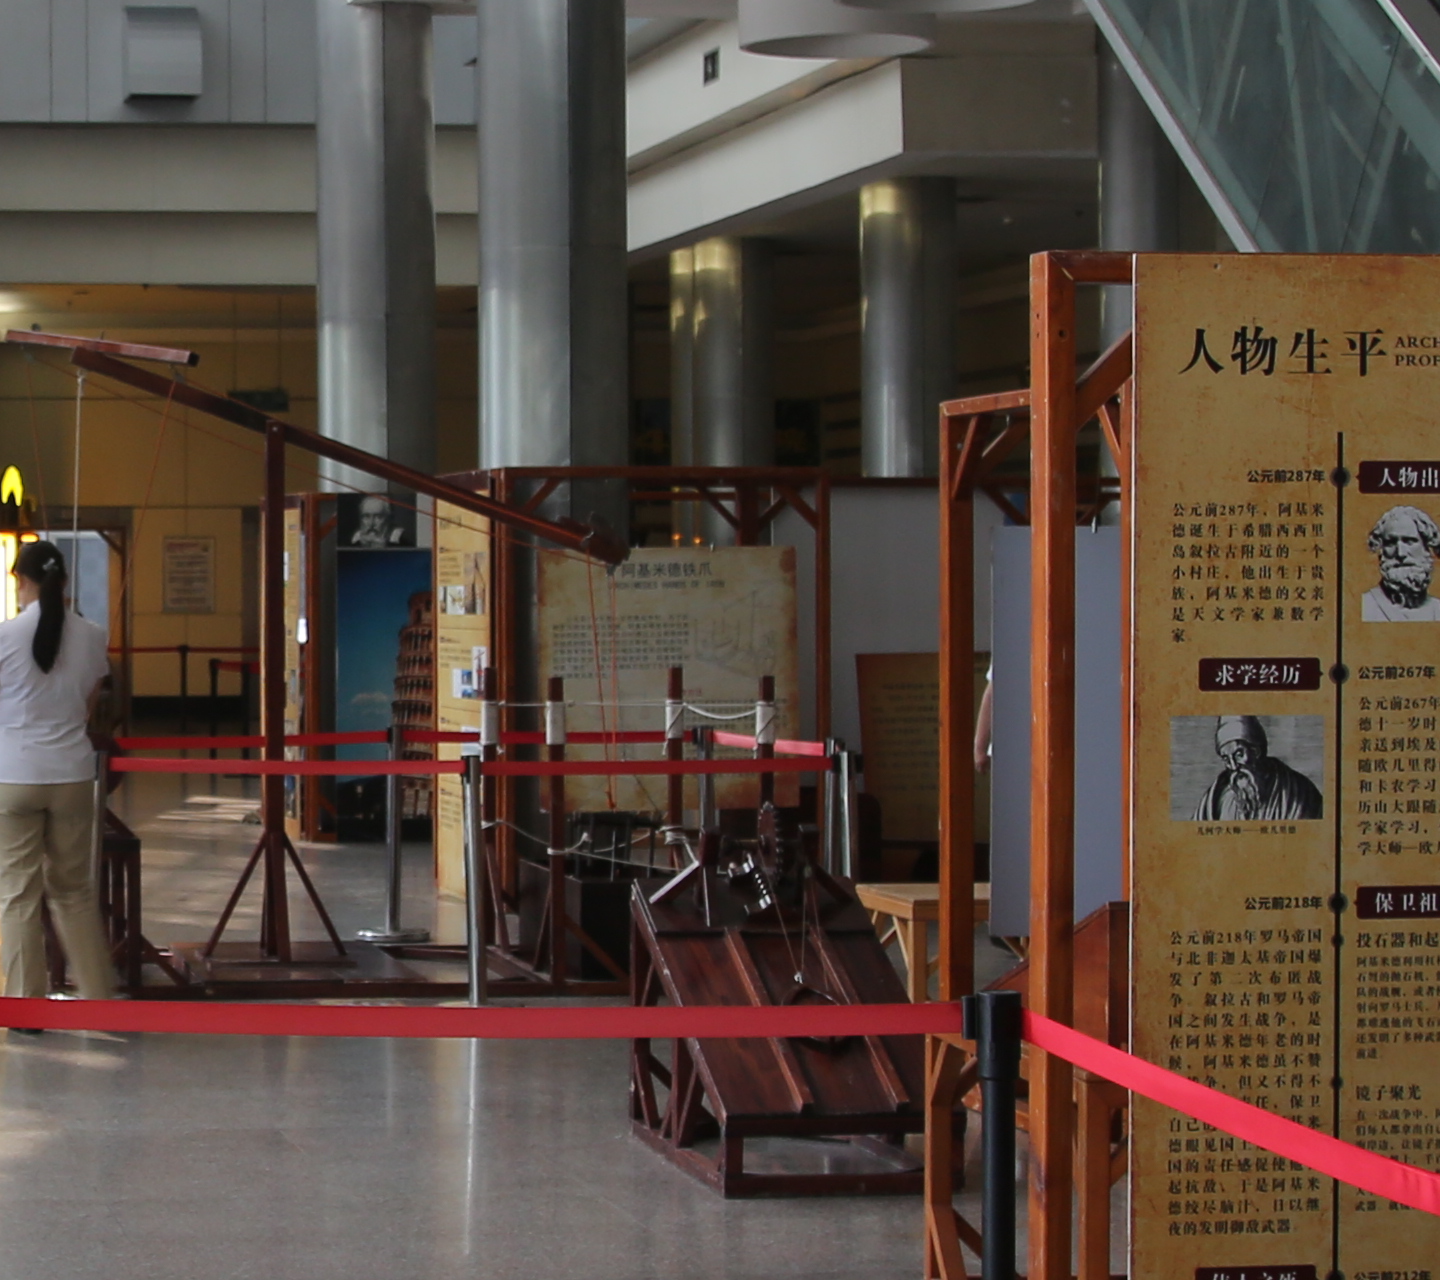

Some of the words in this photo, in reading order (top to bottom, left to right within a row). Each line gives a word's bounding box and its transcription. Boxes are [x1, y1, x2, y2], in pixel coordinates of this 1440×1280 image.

[1178, 325, 1387, 377] 人物生平
[1247, 469, 1325, 483] 公元前287年
[1172, 523, 1324, 538] 德诞生于希腊西西里
[1172, 543, 1324, 559] 岛叙拉古附近的一个
[1172, 606, 1324, 621] 是天文学家兼数学
[1215, 663, 1301, 685] 求学经历
[1358, 665, 1435, 680] 公元前267年
[1245, 896, 1323, 910] 公元前218年
[1170, 928, 1322, 945] 公元前218年罗马帝国
[1170, 1032, 1321, 1050] 在阿基米德年老的时
[1355, 1084, 1422, 1101] 镜子聚光
